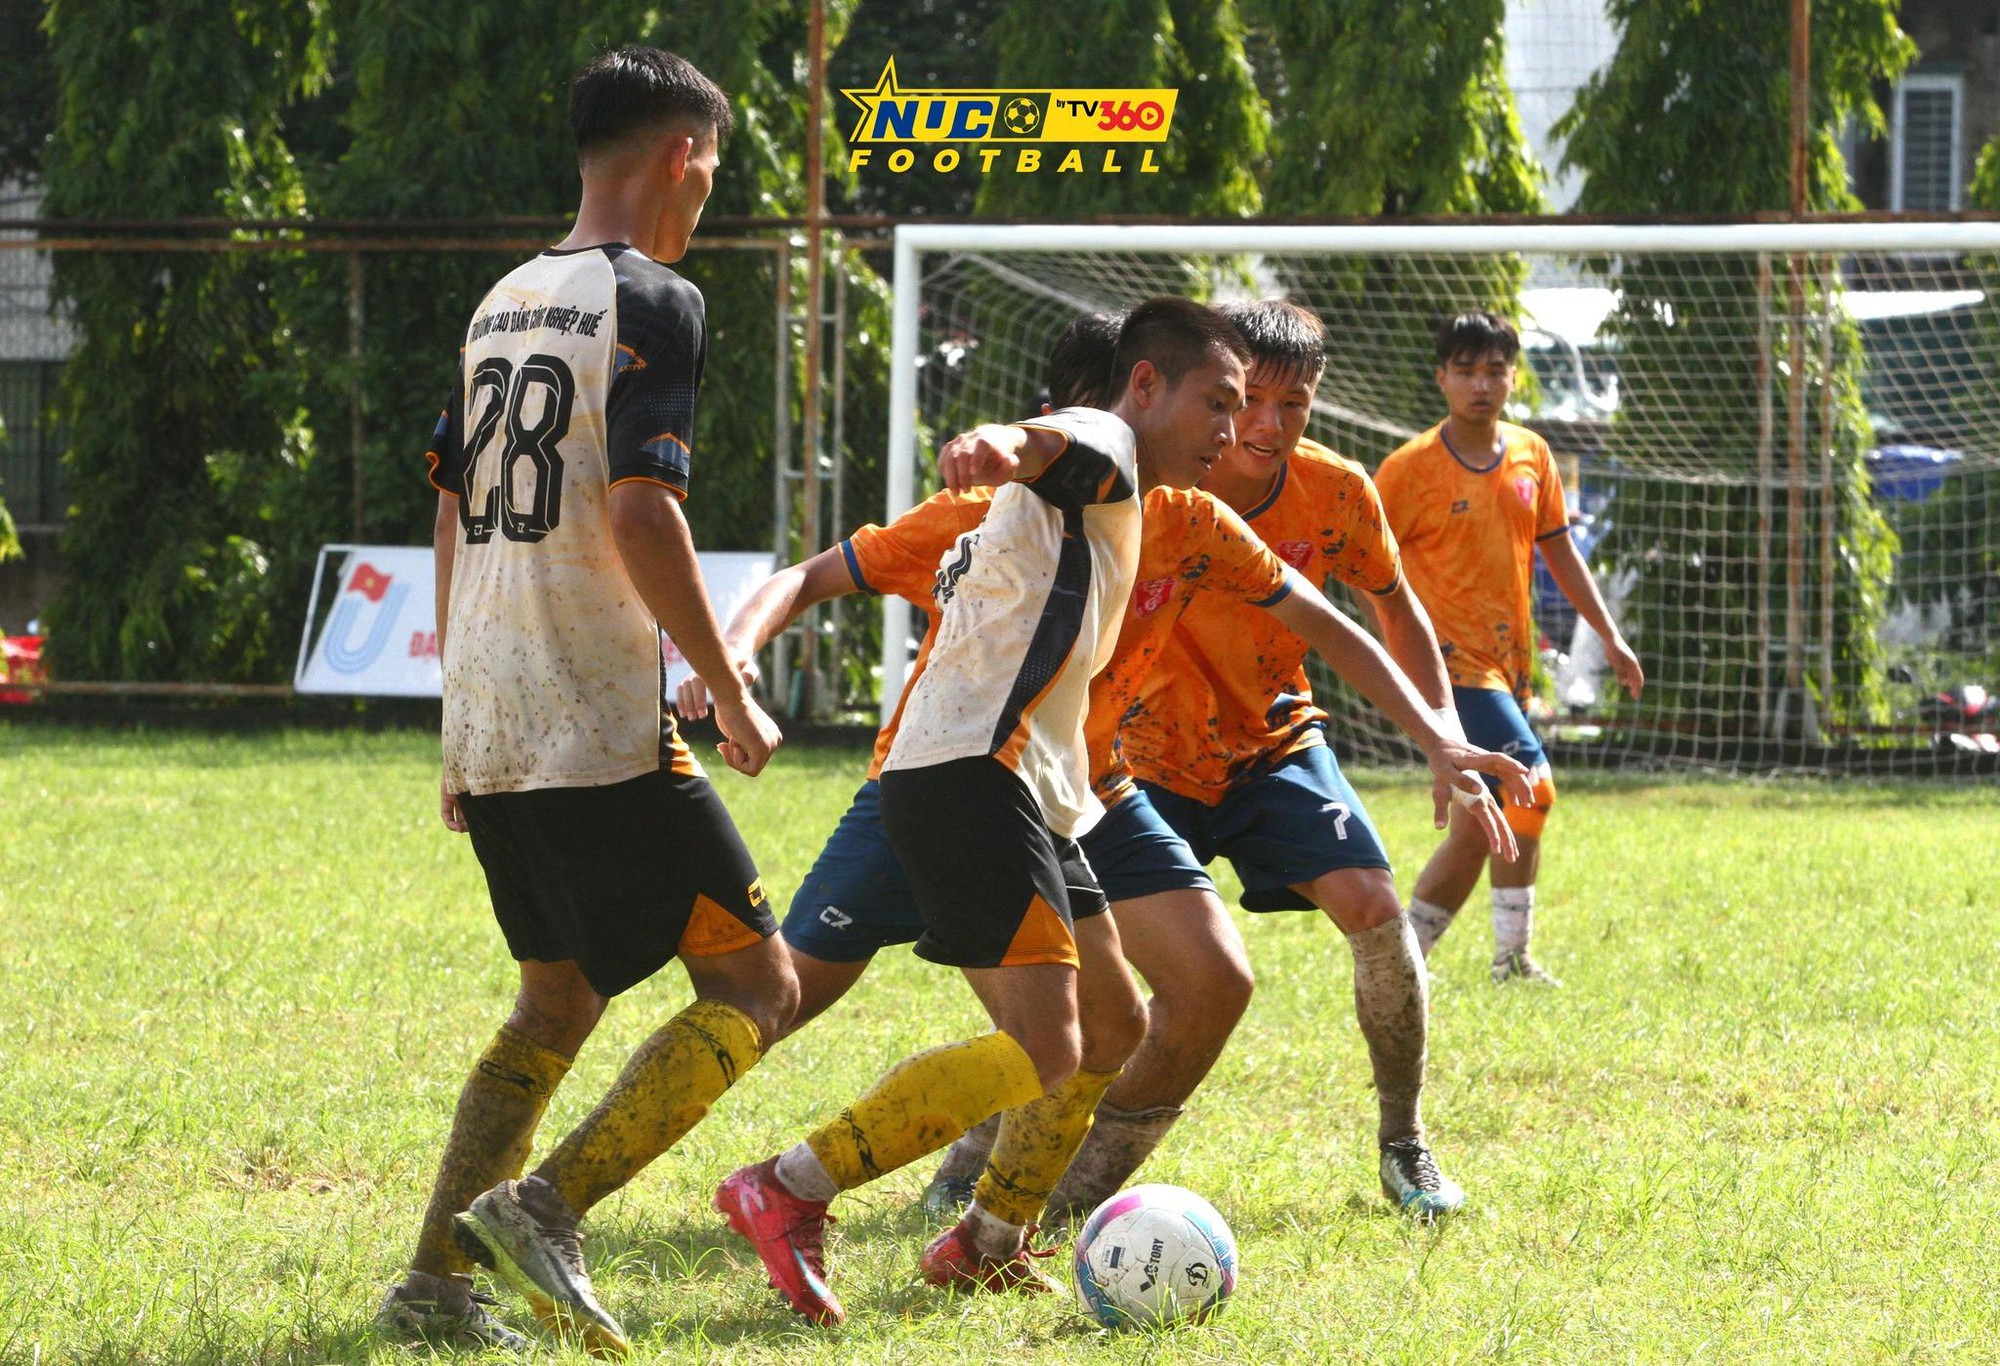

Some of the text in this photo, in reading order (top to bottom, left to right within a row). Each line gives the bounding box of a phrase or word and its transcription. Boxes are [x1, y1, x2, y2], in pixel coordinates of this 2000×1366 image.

[491, 311, 510, 332] CAO
[543, 305, 580, 336] NGHIỆP
[576, 309, 608, 338] HUẾ
[459, 354, 576, 544] 28
[1321, 801, 1352, 840] 7
